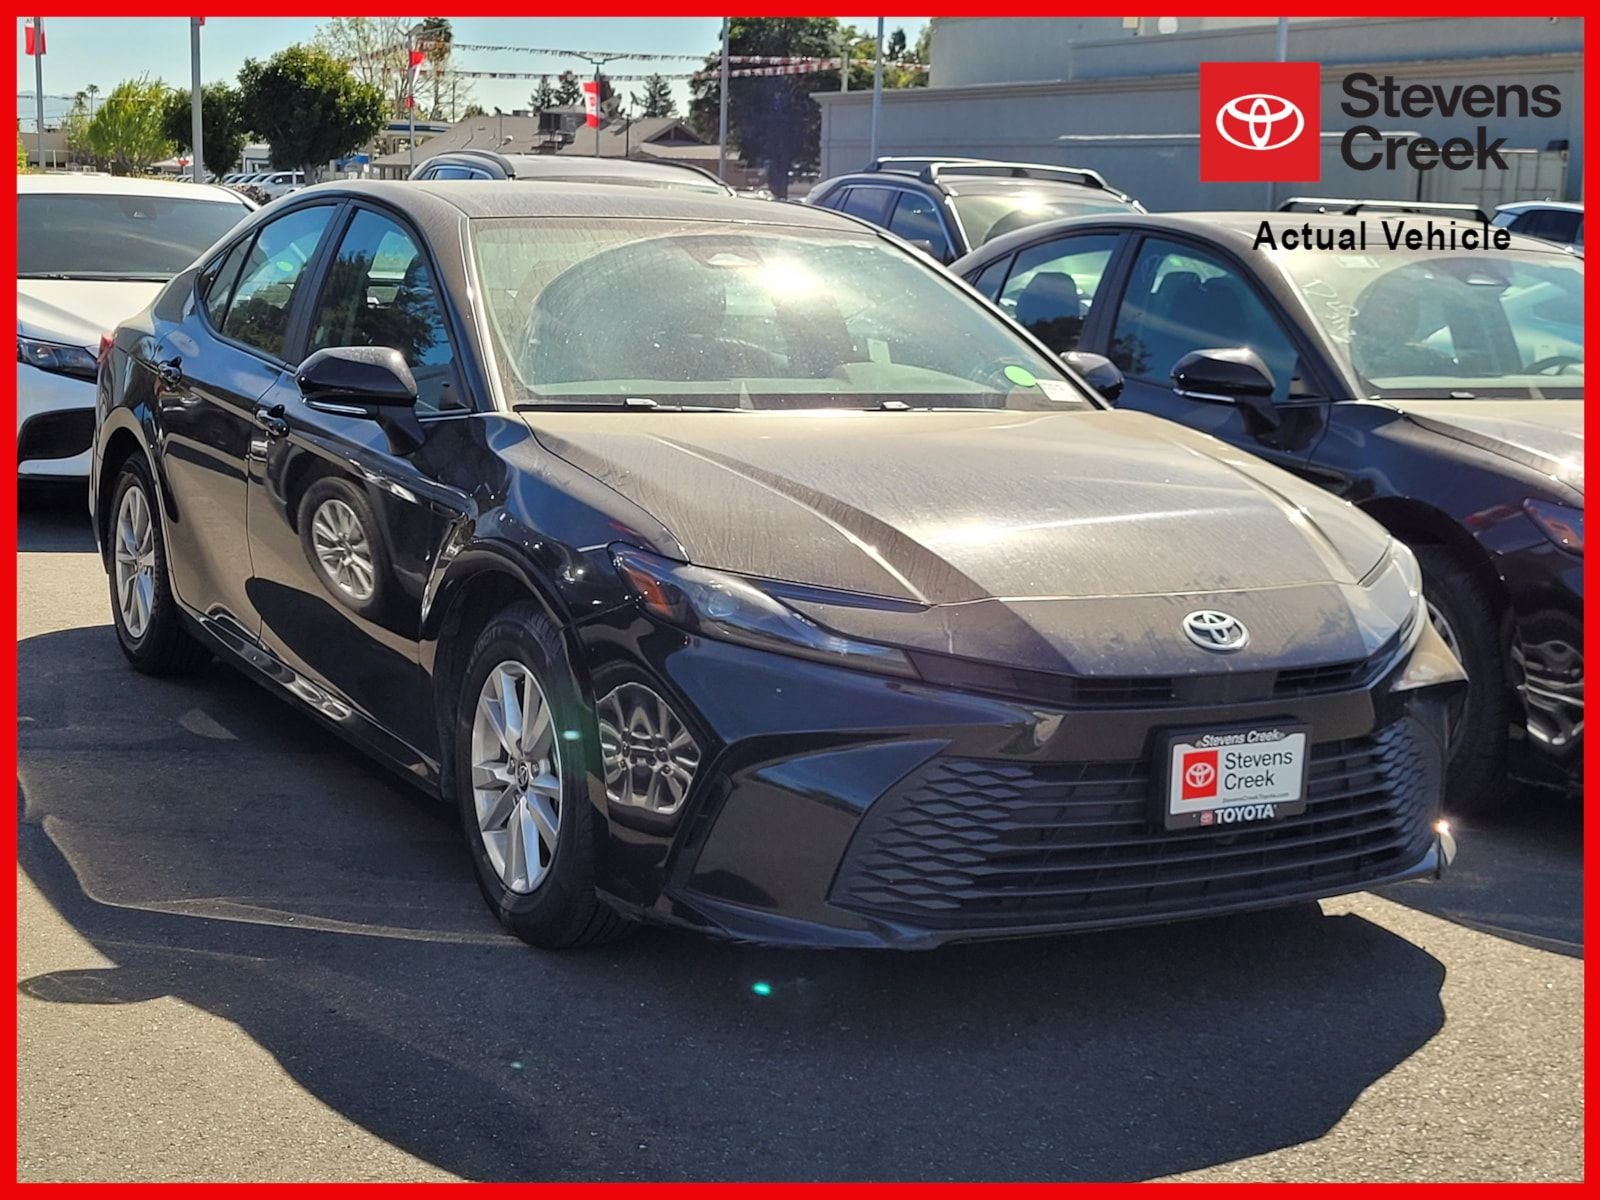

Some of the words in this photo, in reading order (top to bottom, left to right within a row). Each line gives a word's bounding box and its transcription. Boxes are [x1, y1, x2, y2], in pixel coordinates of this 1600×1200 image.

[1201, 733, 1245, 747] Stevens
[1247, 729, 1280, 743] Creek
[1224, 751, 1293, 770] Stevens
[1224, 770, 1275, 790] Creek
[1215, 804, 1275, 824] TOYOTA
